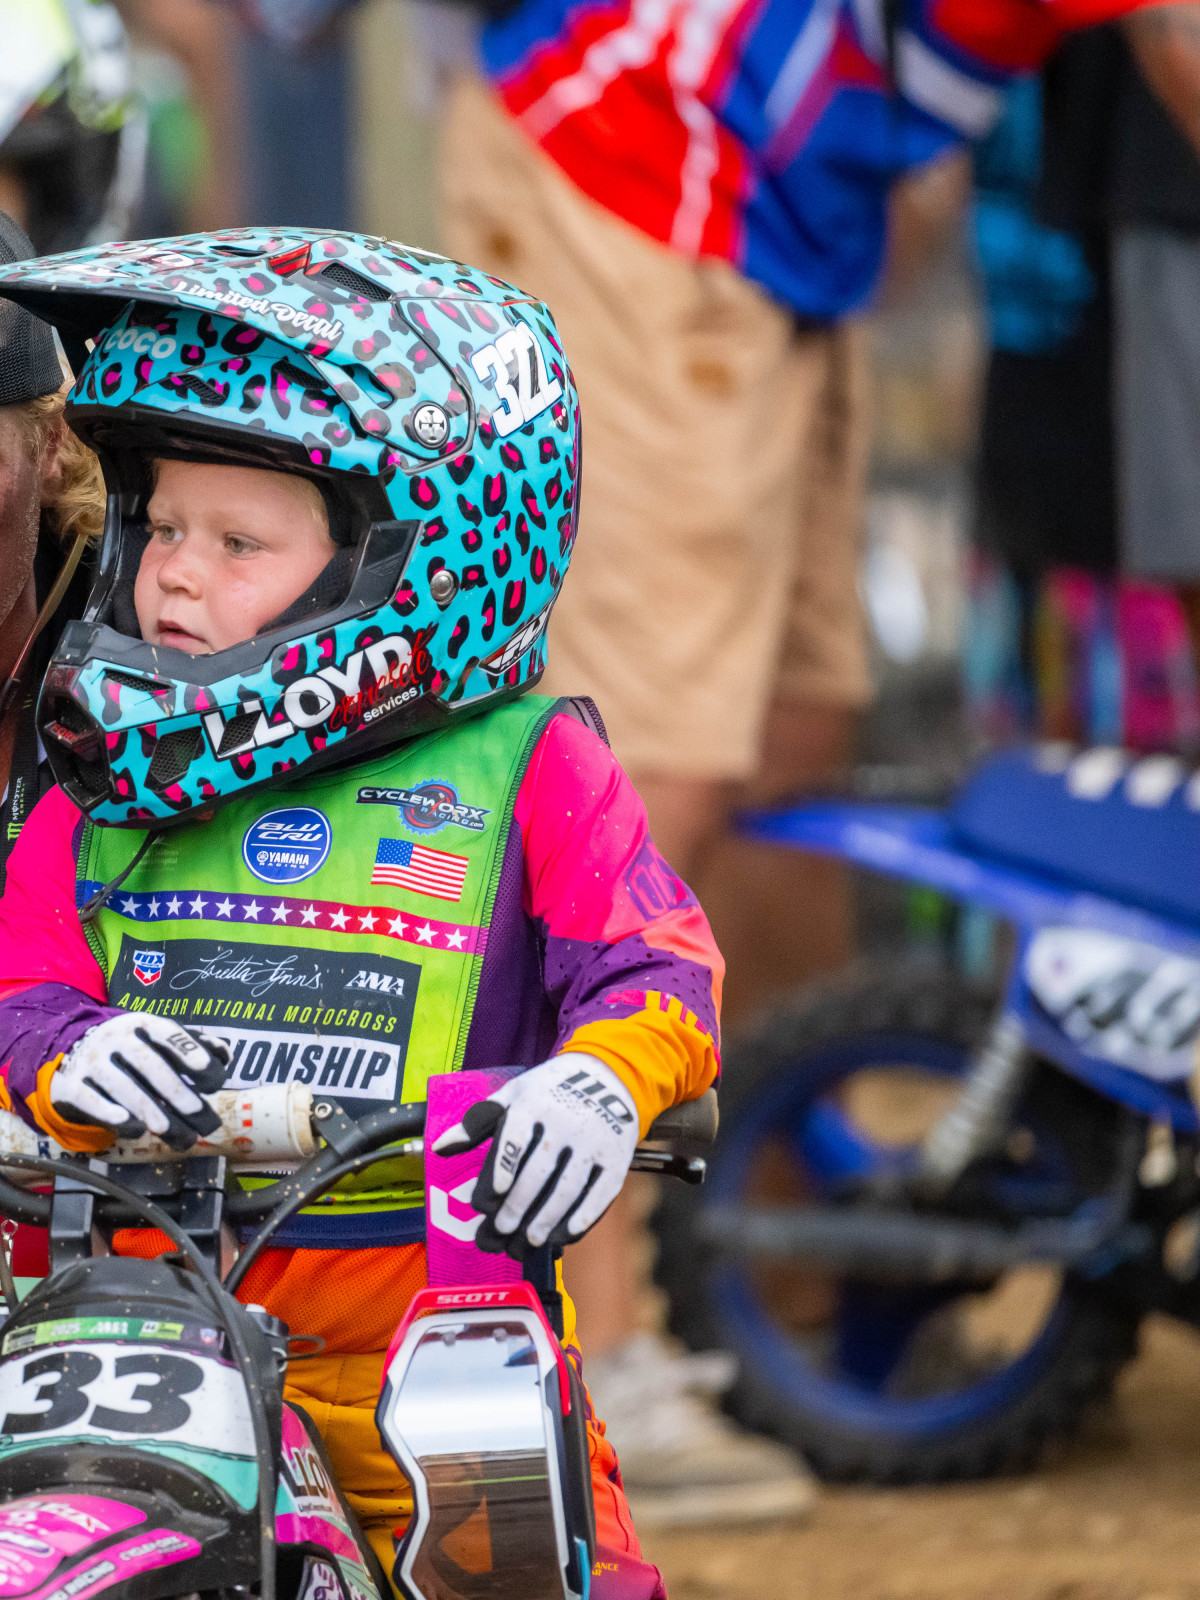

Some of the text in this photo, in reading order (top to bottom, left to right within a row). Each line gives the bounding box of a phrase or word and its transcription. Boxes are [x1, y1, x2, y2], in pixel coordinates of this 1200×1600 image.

[170, 281, 344, 341] Limited Decal
[203, 635, 413, 759] LLOYD
[363, 686, 417, 722] services
[12, 776, 23, 821] MONSTER
[360, 789, 484, 820] CYCLEWORX
[257, 822, 321, 832] BLU
[258, 831, 323, 841] CRU
[269, 851, 310, 866] YAMAHA
[170, 949, 321, 997] Loretta Lynn's
[343, 970, 405, 995] AMA
[117, 992, 398, 1034] AMATEUR NATIONAL MOTOCROSS
[218, 1036, 391, 1089] IONSHIP
[563, 1069, 634, 1125] 110
[436, 1291, 510, 1304] SCOTT
[0, 1351, 204, 1435] 33
